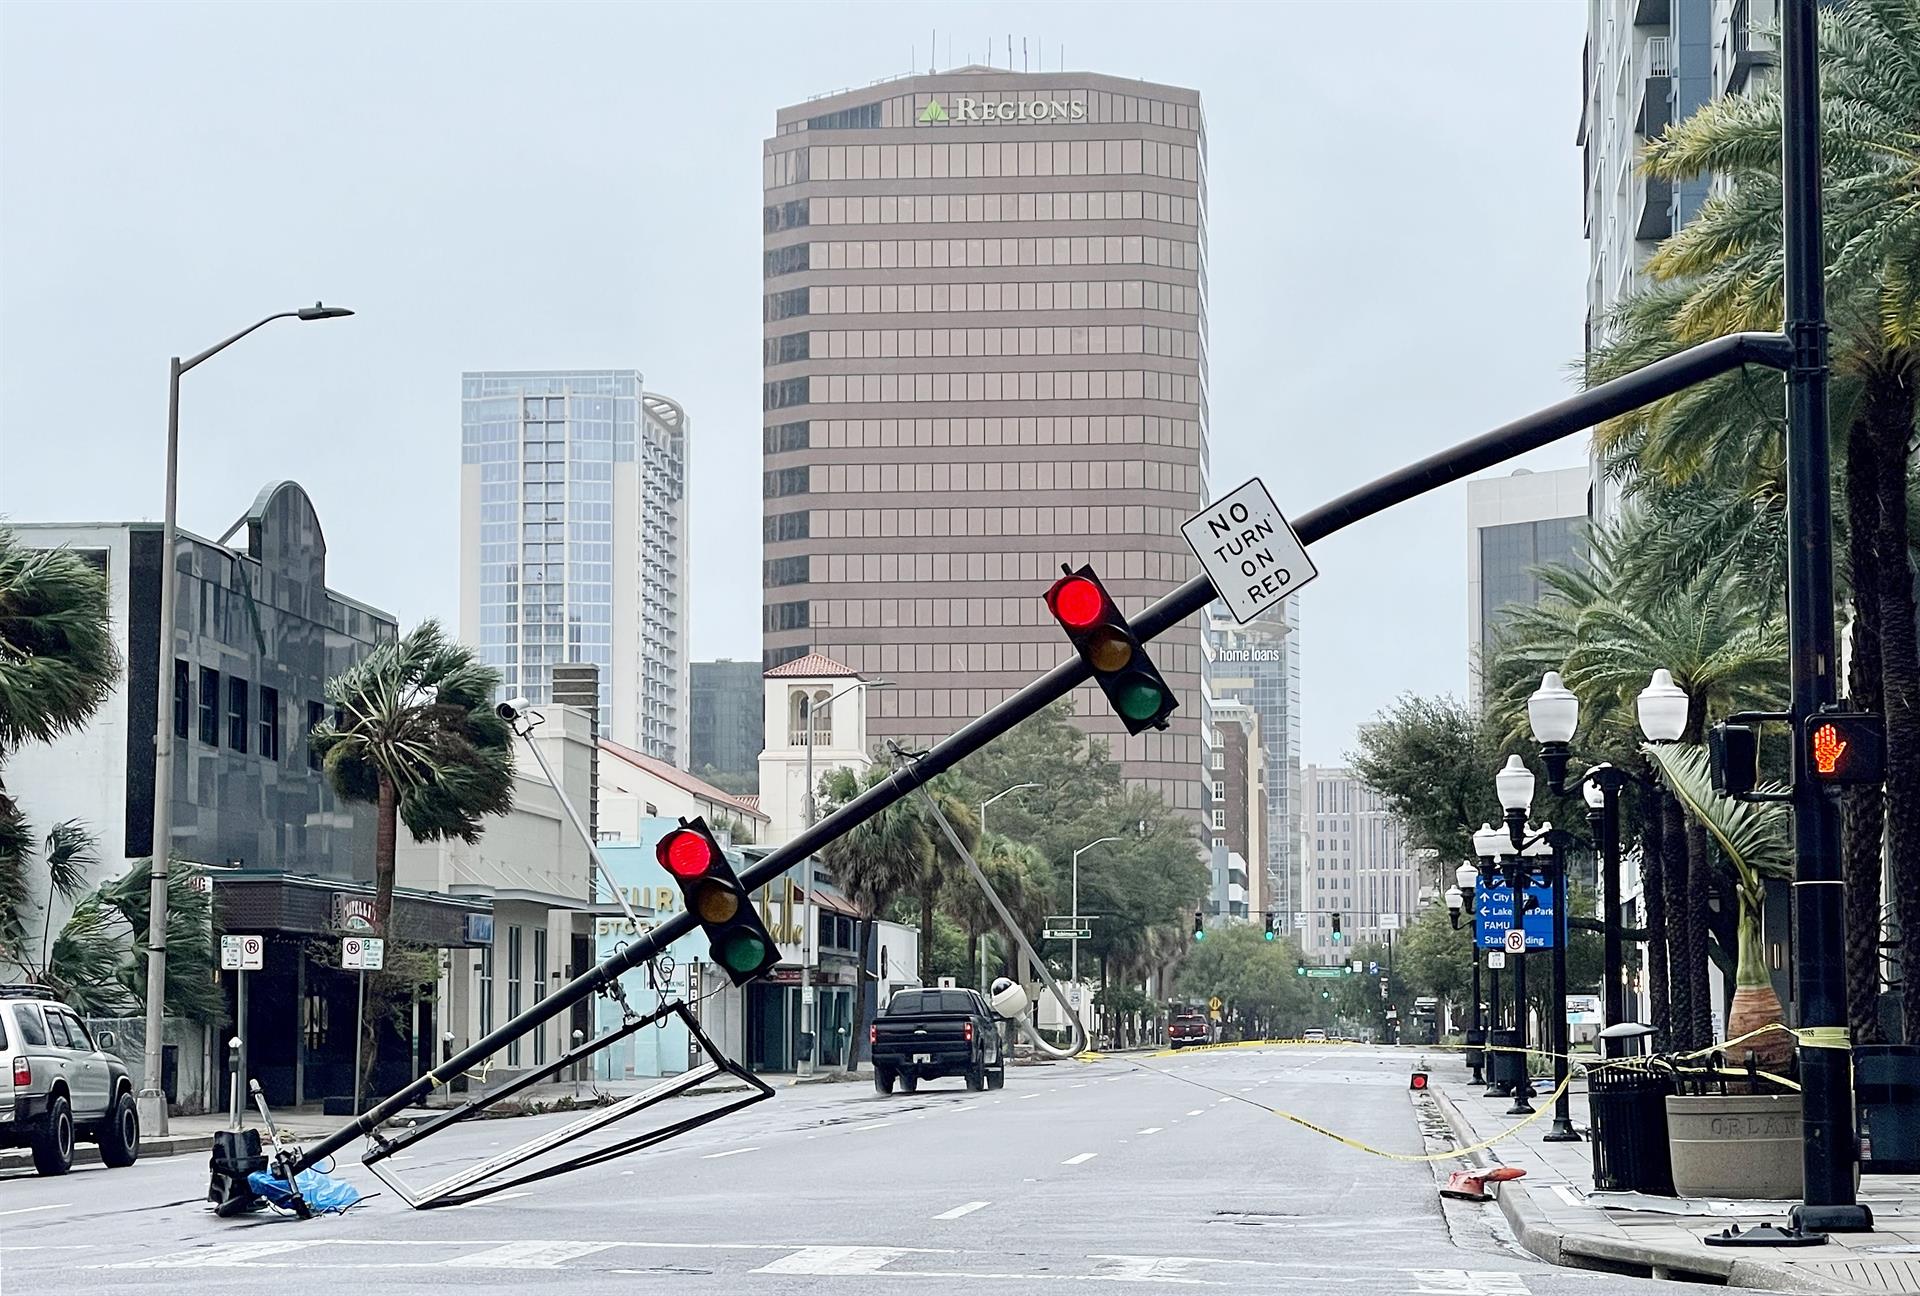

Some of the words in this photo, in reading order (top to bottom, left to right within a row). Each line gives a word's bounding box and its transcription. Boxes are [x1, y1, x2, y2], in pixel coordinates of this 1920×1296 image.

[956, 98, 1086, 121] REGIONS
[1207, 502, 1249, 539] NO
[1214, 519, 1274, 563] TURN
[1241, 548, 1275, 577] ON
[1247, 568, 1291, 604] RED
[1219, 646, 1250, 662] home
[1251, 645, 1280, 662] loans
[1492, 893, 1510, 903] City
[1492, 907, 1513, 916] Lake
[1484, 921, 1510, 930] FAMU
